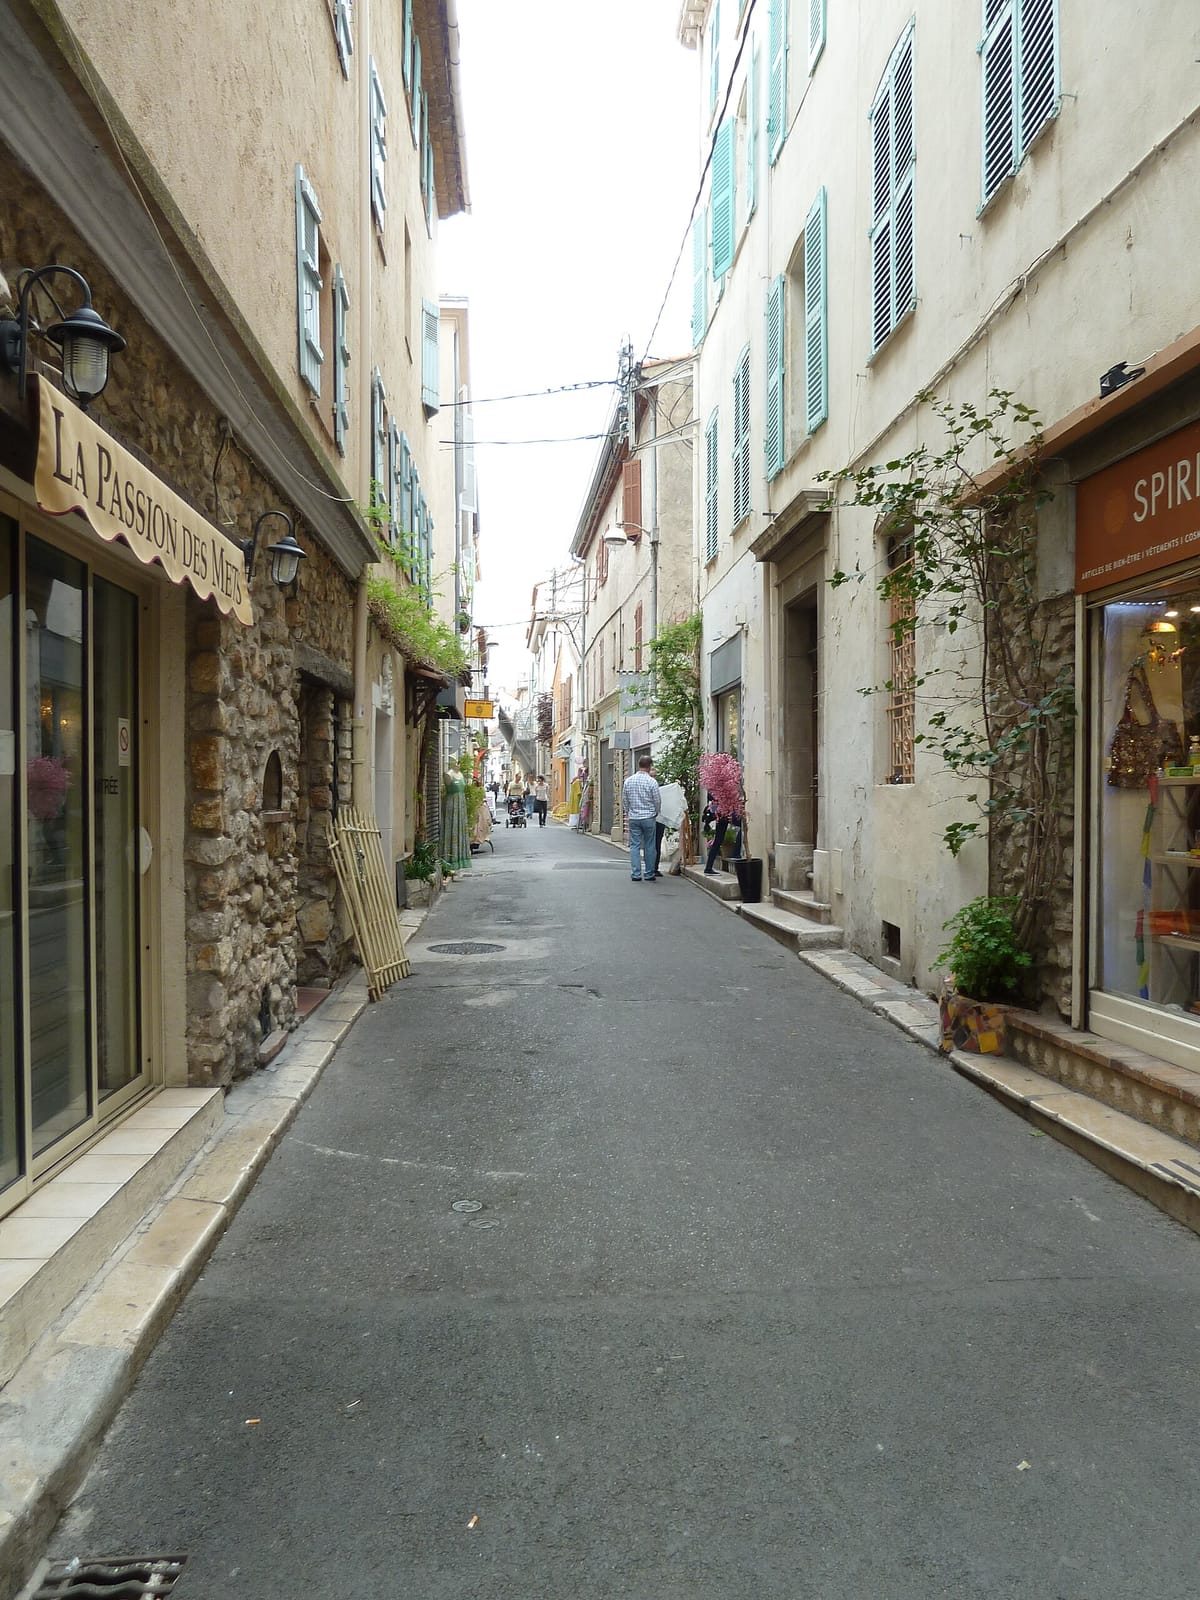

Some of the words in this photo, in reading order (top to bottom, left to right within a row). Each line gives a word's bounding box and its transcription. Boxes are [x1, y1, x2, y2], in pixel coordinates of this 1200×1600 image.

[52, 406, 89, 500] LA
[96, 442, 178, 560] PASSION
[182, 525, 208, 581] DES
[211, 539, 242, 605] METS
[1081, 565, 1104, 580] ARTICLES
[1104, 562, 1112, 572] DE
